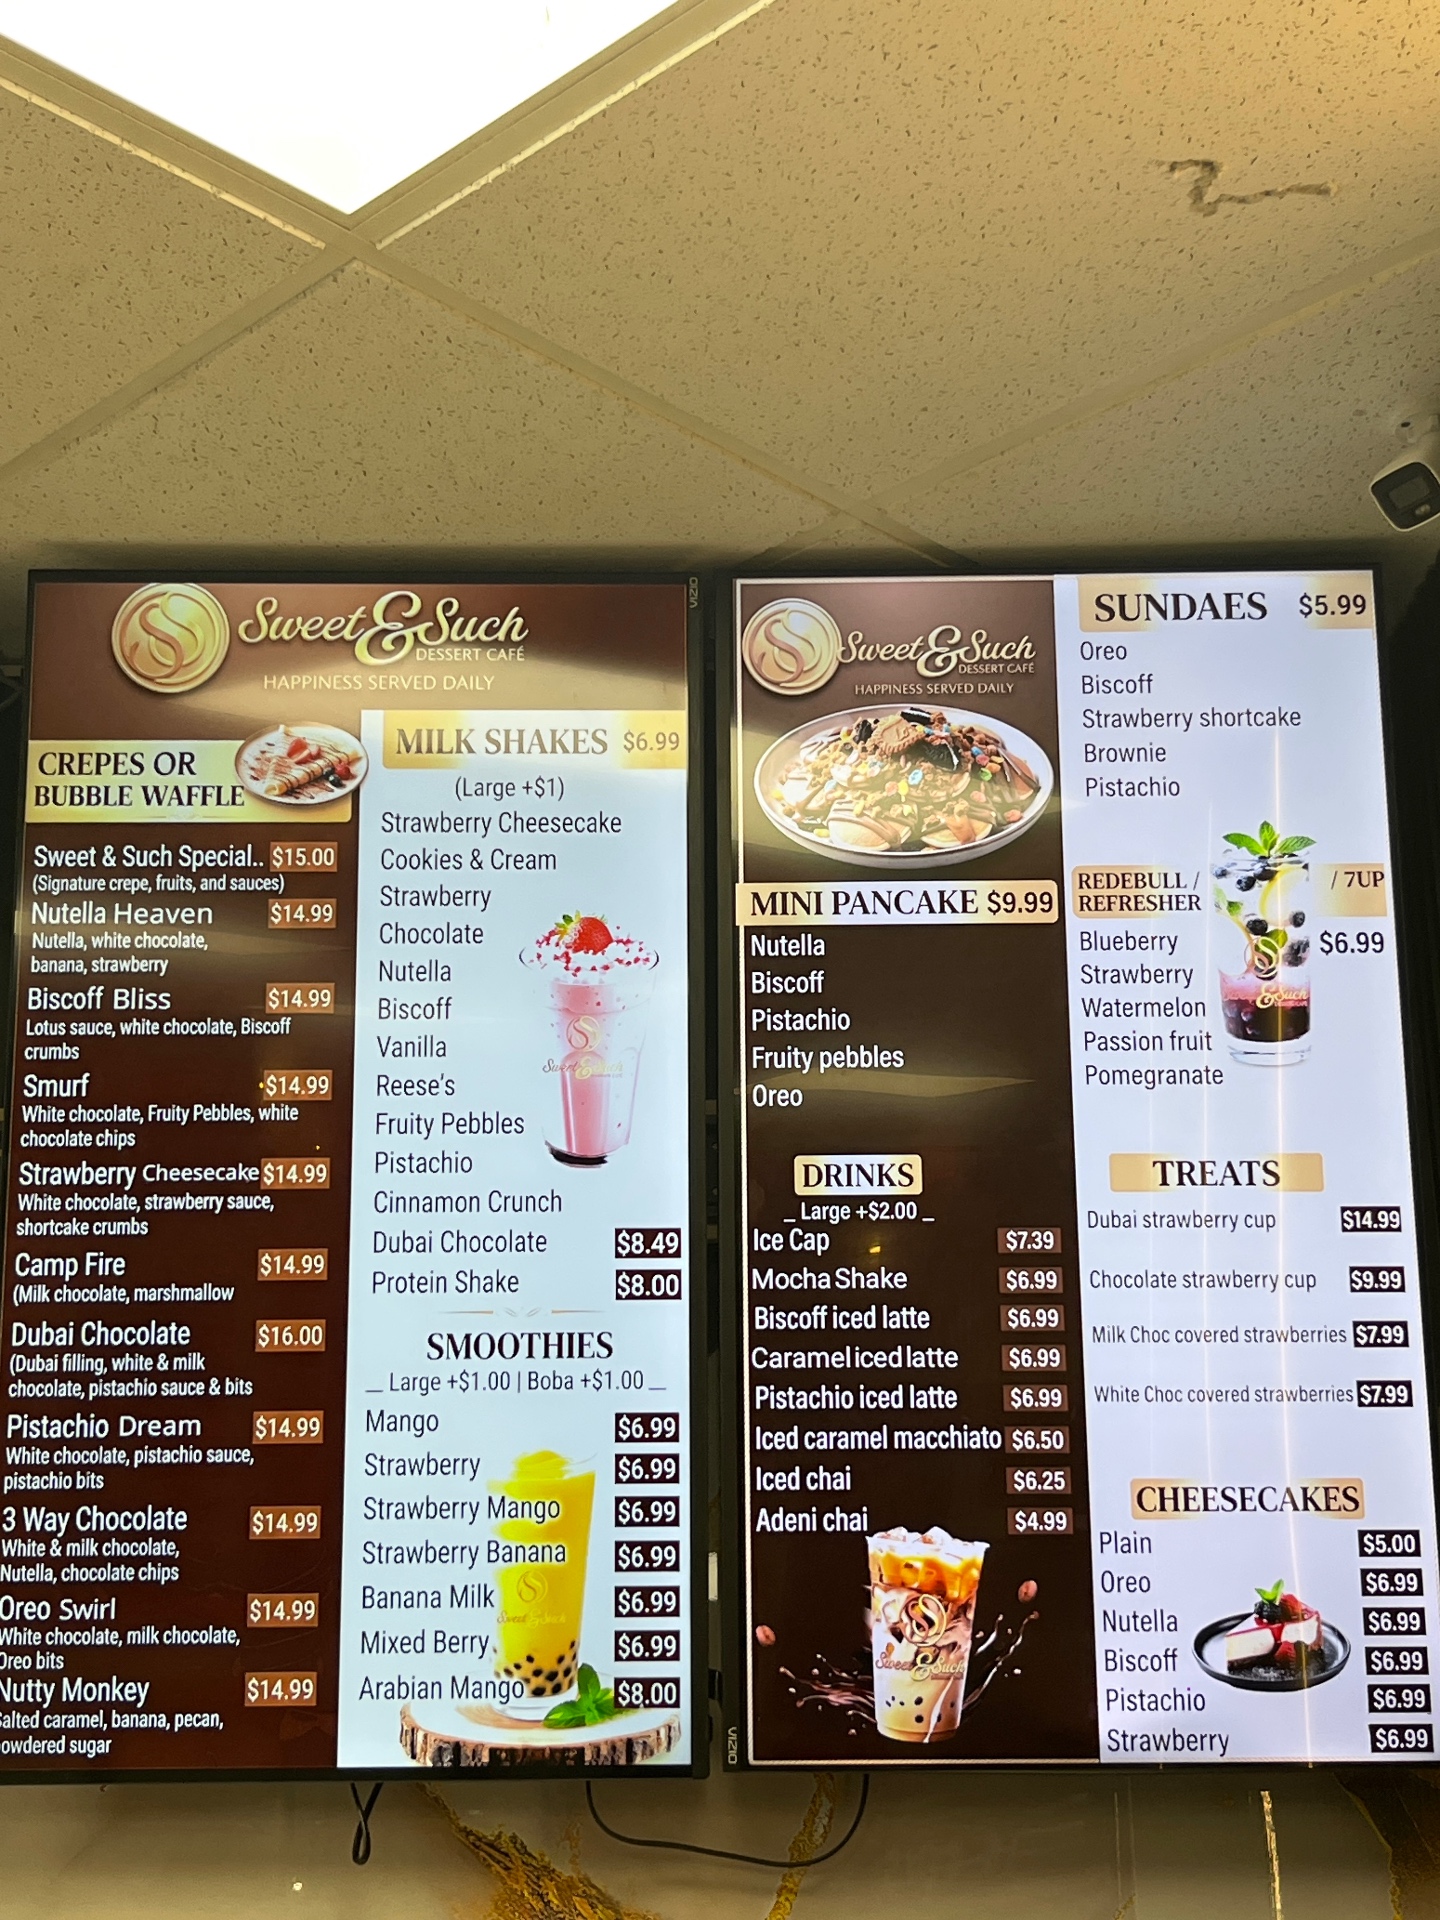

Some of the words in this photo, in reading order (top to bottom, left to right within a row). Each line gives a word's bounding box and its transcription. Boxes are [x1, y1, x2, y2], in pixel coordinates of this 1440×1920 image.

[1095, 592, 1267, 621] SUNDAES
[1300, 594, 1366, 618] $5.99
[238, 596, 367, 644] Sweet
[355, 591, 424, 666] &
[411, 597, 529, 644] Such
[416, 648, 481, 661] DESSERT
[487, 644, 524, 661] CAFÉ
[836, 631, 925, 663] Sweet
[917, 625, 964, 677] &
[958, 630, 1036, 662] Such
[959, 664, 1004, 674] DESSERT
[1007, 663, 1034, 673] CAFÉ
[263, 675, 362, 690] HAPPINESS
[368, 675, 437, 690] SERVED
[443, 675, 494, 690] DAILY
[1083, 709, 1193, 732] Strawberry
[1200, 707, 1301, 727] shortcake
[396, 728, 475, 754] MILK
[485, 728, 608, 755] SHAKES
[623, 730, 680, 753] $6.99
[1084, 742, 1166, 763] Brownie
[38, 752, 145, 775] CREPES
[154, 752, 196, 775] OR
[34, 786, 132, 807] BUBBLE
[141, 786, 244, 806] WAFFLE
[455, 777, 515, 800] (Large
[522, 775, 564, 800] +$1)
[381, 812, 491, 838] Strawberry
[499, 811, 622, 833] Cheesecake
[34, 845, 96, 867] Sweet
[102, 848, 116, 867] &
[122, 845, 172, 867] Such
[272, 848, 334, 868] $15.00
[381, 849, 462, 870] Cookies
[470, 850, 483, 870] &
[491, 849, 556, 870] Cream
[32, 876, 106, 895] (Signature
[109, 877, 152, 894] crepe,
[156, 875, 196, 892] fruits,
[200, 875, 226, 891] and
[230, 874, 284, 894] sauces)
[1078, 872, 1188, 890] REDEBULL
[1344, 871, 1384, 888] 7UP
[31, 902, 106, 924] Nutella
[114, 903, 213, 924] Heaven
[270, 904, 333, 925] $14.99
[751, 891, 823, 915] MINI
[832, 890, 979, 915] PANCAKE
[987, 890, 1053, 916] $9.99
[1078, 895, 1201, 912] REFRESHER
[1320, 930, 1385, 955] $6.99
[28, 987, 104, 1010] Biscoff
[113, 989, 170, 1010] Bliss
[268, 989, 331, 1010] $14.99
[1081, 998, 1206, 1018] Watermelon
[26, 1019, 66, 1035] Lotus
[69, 1021, 116, 1037] sauce,
[120, 1018, 159, 1035] white
[163, 1018, 237, 1036] chocolate,
[241, 1017, 291, 1034] Biscoff
[752, 1008, 850, 1031] Pistachio
[377, 1035, 446, 1057] Vanilla
[1084, 1031, 1163, 1051] Passion
[1169, 1030, 1212, 1051] fruit
[752, 1047, 814, 1074] Fruity
[819, 1045, 904, 1073] pebbles
[23, 1073, 90, 1097] Smurf
[266, 1074, 329, 1096] $14.99
[376, 1074, 455, 1096] Reese's
[376, 1112, 434, 1140] Fruity
[442, 1112, 524, 1134] Pebbles
[20, 1131, 92, 1147] chocolate
[96, 1129, 135, 1150] chips
[19, 1161, 136, 1190] Strawberry
[143, 1163, 259, 1183] Cheesecake
[263, 1163, 327, 1186] $14.99
[802, 1163, 914, 1187] DRINKS
[1152, 1160, 1280, 1187] TREATS
[374, 1190, 480, 1213] Cinnamon
[488, 1189, 561, 1212] Crunch
[801, 1202, 850, 1224] Large
[856, 1201, 917, 1220] +$2.00
[1087, 1210, 1137, 1228] Dubai
[1143, 1210, 1238, 1232] strawberry
[1244, 1213, 1276, 1231] cup
[1343, 1210, 1400, 1231] $14.99
[373, 1230, 432, 1253] Dubai
[441, 1230, 547, 1253] Chocolate
[617, 1231, 679, 1256] $8.49
[754, 1229, 783, 1251] Ice
[789, 1228, 829, 1256] Cap
[1006, 1230, 1054, 1251] $7.39
[15, 1253, 78, 1281] Camp
[85, 1252, 125, 1275] Fire
[260, 1253, 325, 1277] $14.99
[752, 1267, 831, 1289] Mocha
[835, 1266, 908, 1288] Shake
[1007, 1269, 1057, 1290] $6.99
[13, 1285, 50, 1306] (Milk
[54, 1285, 130, 1304] chocolate,
[134, 1283, 234, 1301] marshmallow
[372, 1270, 447, 1293] Protein
[455, 1270, 519, 1293] Shake
[617, 1272, 679, 1297] $8.00
[12, 1322, 74, 1346] Dubai
[81, 1320, 190, 1346] Chocolate
[258, 1325, 323, 1347] $16.00
[427, 1332, 613, 1360] SMOOTHIES
[390, 1372, 440, 1396] Large
[447, 1370, 510, 1392] +$1.00
[528, 1370, 573, 1390] Boba
[581, 1369, 643, 1391] +$1.00
[1094, 1385, 1139, 1402] White
[1144, 1386, 1183, 1403] Choc
[1187, 1385, 1249, 1402] covered
[1254, 1384, 1353, 1402] strawberries
[1360, 1385, 1408, 1405] $7.99
[7, 1413, 109, 1439] Pistachio
[120, 1415, 201, 1436] Dream
[255, 1416, 320, 1439] $14.99
[755, 1427, 798, 1450] Iced
[804, 1425, 887, 1449] caramel
[894, 1425, 1001, 1449] macchiato
[1012, 1429, 1064, 1451] $6.50
[756, 1466, 799, 1490] Iced
[806, 1466, 851, 1490] chai
[1014, 1470, 1065, 1492] $6.25
[364, 1496, 480, 1525] Strawberry
[488, 1496, 560, 1523] Mango
[618, 1499, 676, 1523] $6.99
[1137, 1486, 1360, 1512] CHEESECAKES
[2, 1507, 15, 1531] 3
[23, 1506, 70, 1536] Way
[76, 1505, 187, 1531] Chocolate
[252, 1511, 318, 1534] $14.99
[756, 1507, 816, 1532] Adeni
[823, 1506, 867, 1531] chai
[1015, 1511, 1066, 1533] $4.99
[1100, 1531, 1151, 1554] Plain
[1363, 1533, 1415, 1555] $5.00
[0, 1596, 51, 1620] Oreo
[59, 1598, 116, 1620] Swirl
[250, 1599, 315, 1623] $14.99
[361, 1629, 425, 1654] Mixed
[433, 1631, 489, 1659] Berry
[618, 1633, 676, 1660] $6.99
[0, 1677, 55, 1708] Nutty
[62, 1676, 149, 1707] Monkey
[247, 1678, 313, 1702] $14.99
[359, 1675, 442, 1700] Arabian
[451, 1675, 524, 1703] Mango
[618, 1679, 676, 1706] $8.00
[728, 1727, 737, 1764] VIZIO
[1107, 1728, 1229, 1756] Strawberry
[1375, 1728, 1428, 1750] $6.99
